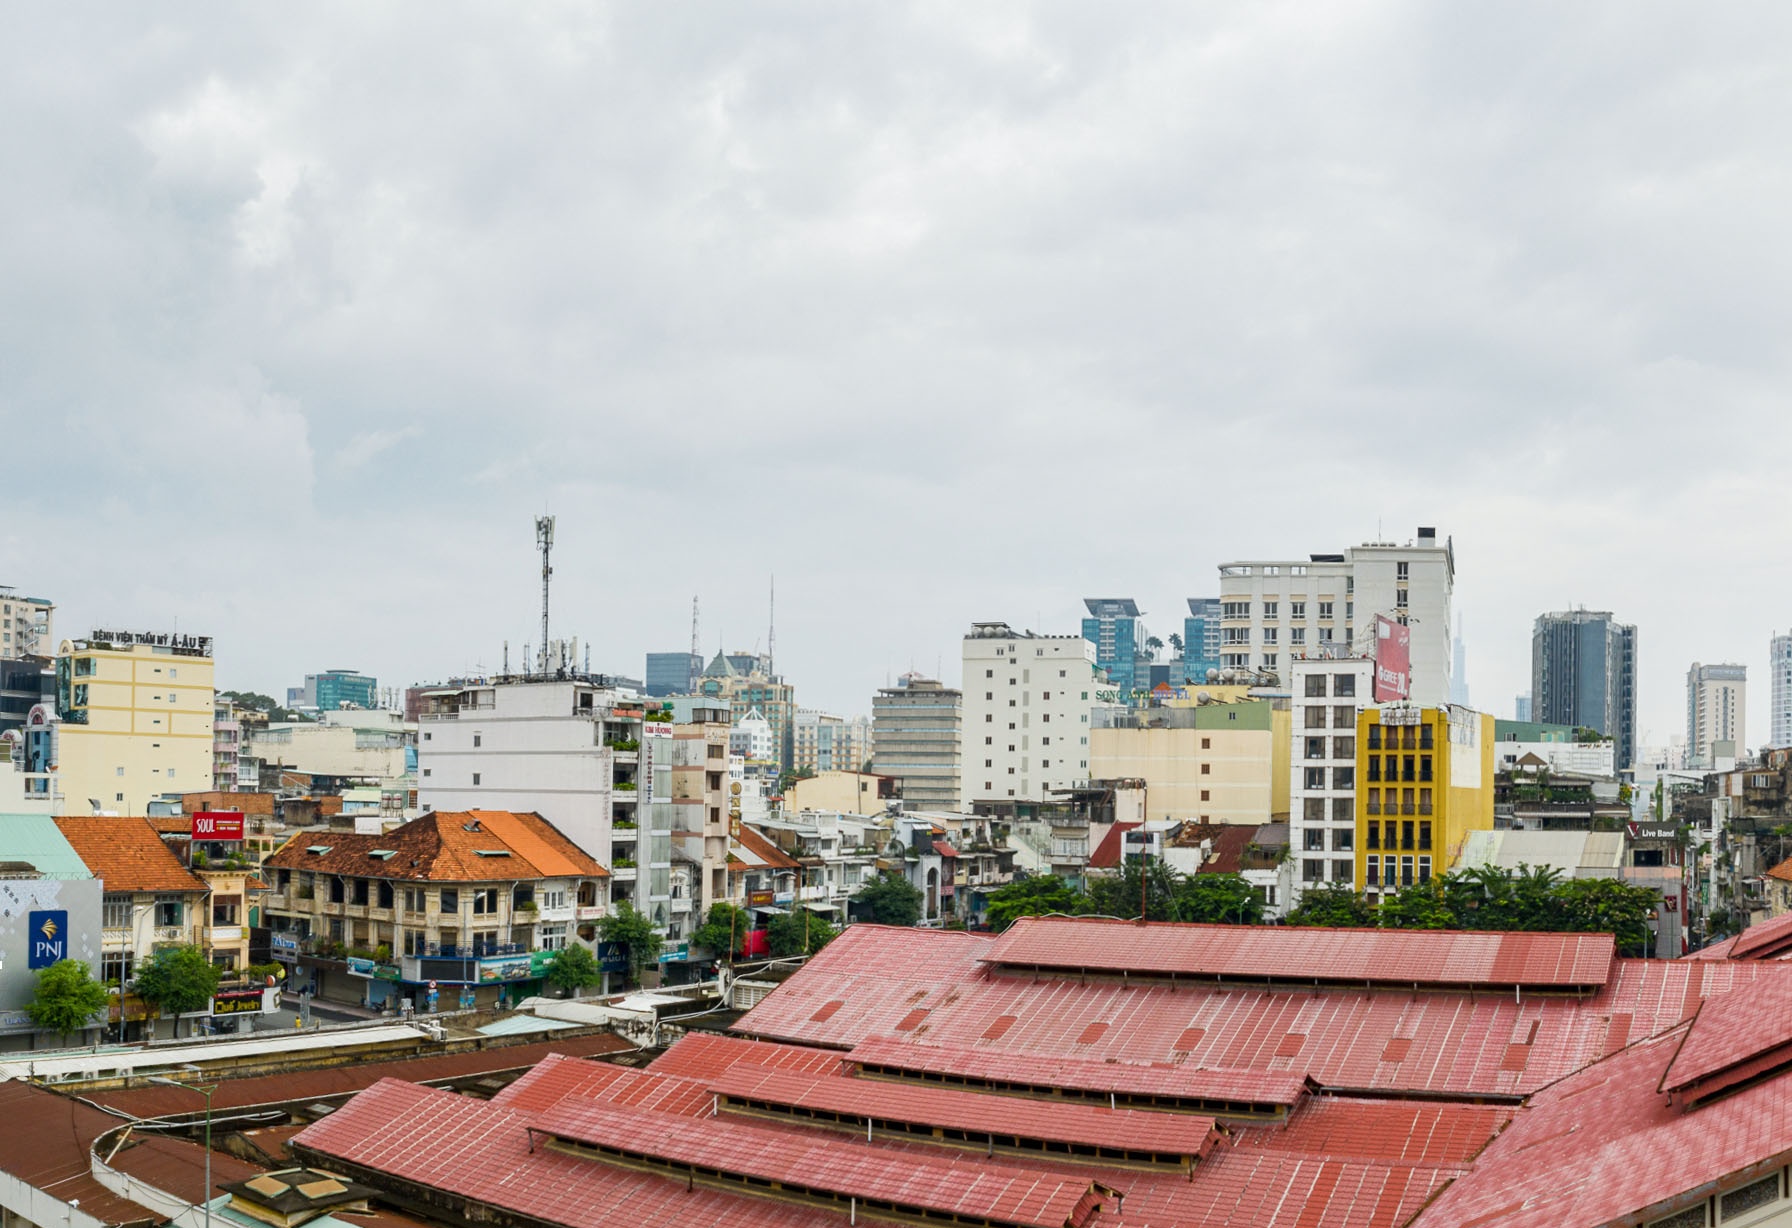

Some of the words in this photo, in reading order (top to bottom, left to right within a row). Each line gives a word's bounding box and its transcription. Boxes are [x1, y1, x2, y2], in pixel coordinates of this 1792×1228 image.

[196, 818, 215, 833] SOUL
[1642, 829, 1656, 837] Live
[1658, 829, 1674, 838] Band
[36, 941, 62, 960] PNJ
